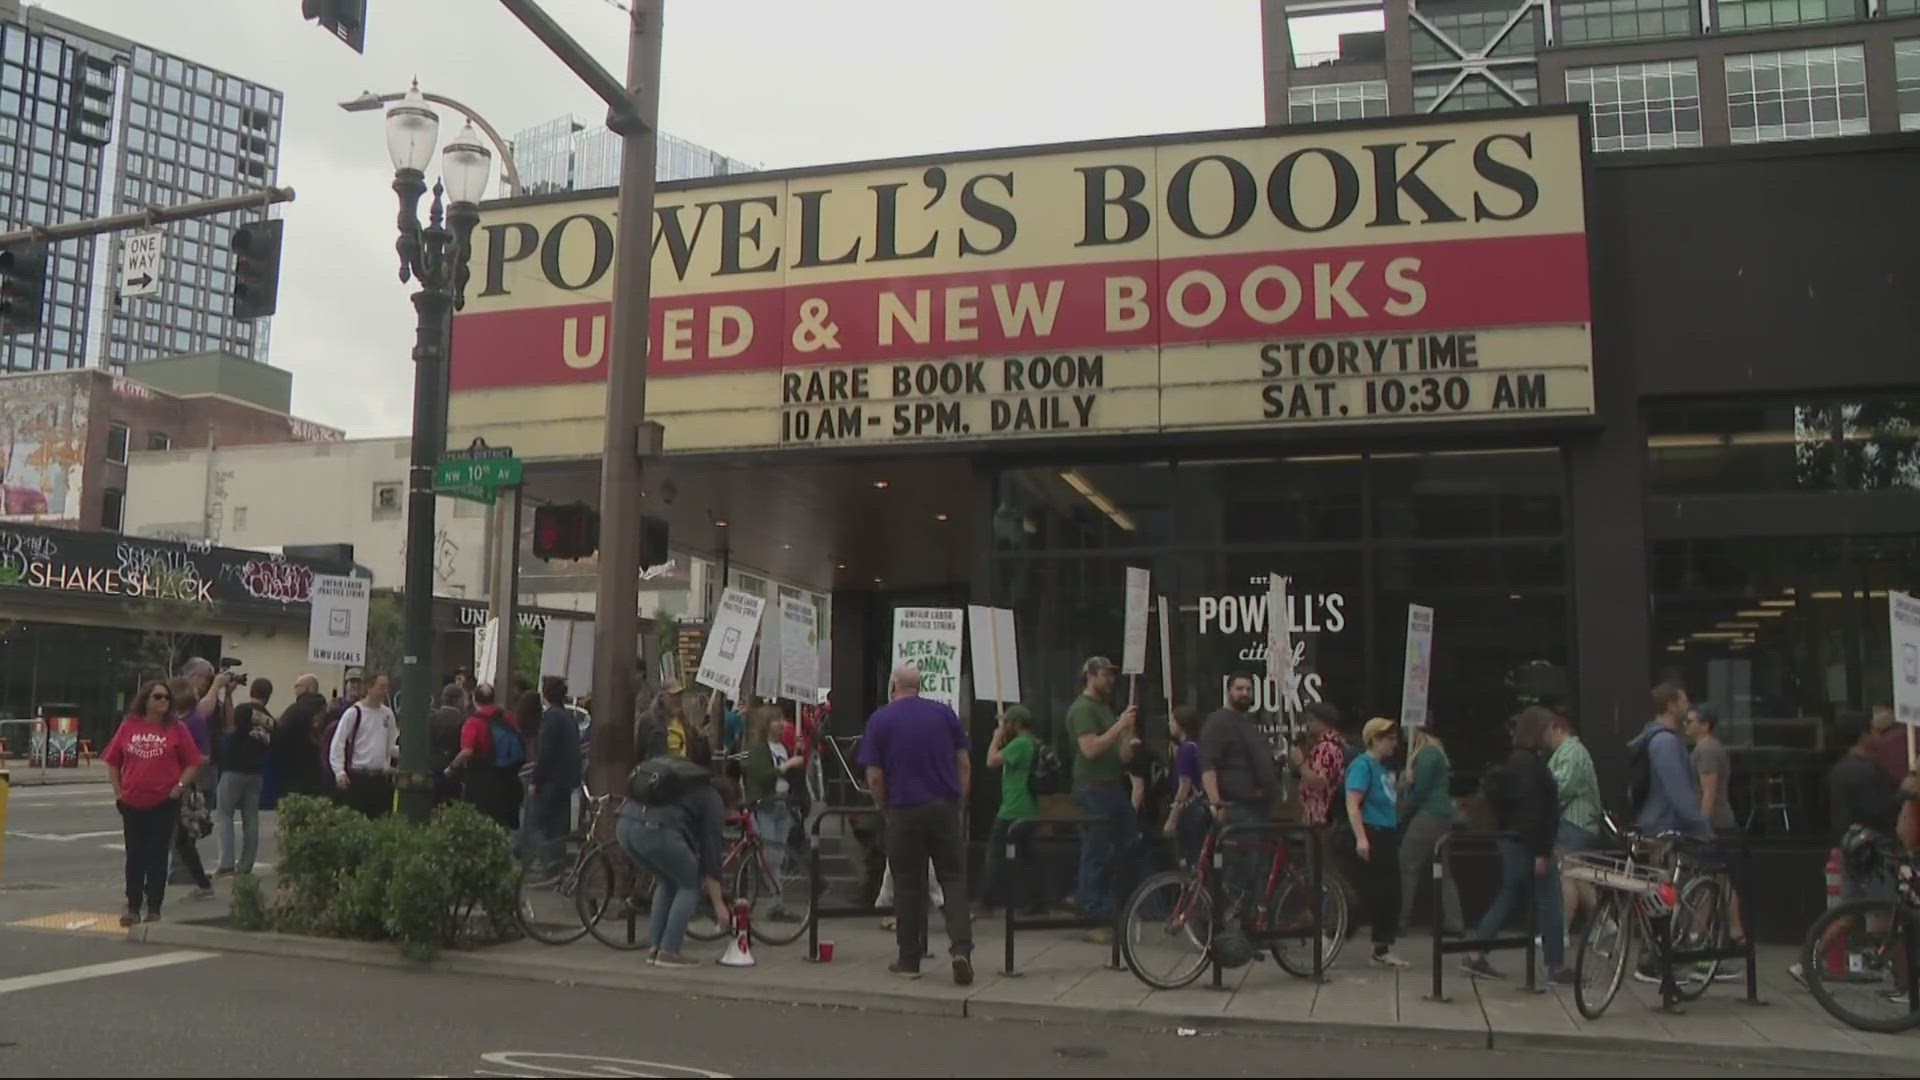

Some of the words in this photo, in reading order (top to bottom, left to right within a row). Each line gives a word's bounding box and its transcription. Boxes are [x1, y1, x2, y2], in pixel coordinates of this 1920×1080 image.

[477, 166, 1018, 299] POWELL'S
[1072, 131, 1540, 250] BOOKS
[131, 237, 156, 254] ONE
[129, 253, 156, 270] WAY
[562, 305, 754, 370] UED
[791, 297, 842, 351] &
[878, 280, 1065, 347] NEW
[1104, 256, 1428, 333] BOOKS
[1260, 334, 1479, 378] STORYTIME
[782, 367, 869, 403] RARE
[892, 361, 986, 398] BOOK
[1003, 355, 1104, 392] ROOM
[1365, 376, 1470, 415] 10:30
[1491, 373, 1547, 410] AM
[990, 394, 1096, 432] DAILY
[445, 471, 461, 482] NW
[498, 468, 511, 479] AV
[28, 562, 121, 595] SHAKE
[126, 571, 215, 608] SHACK
[318, 586, 344, 597] PRACTICE
[345, 589, 365, 599] STRIKE
[322, 579, 342, 589] UNFAIR
[344, 581, 363, 591] LABOR
[1199, 593, 1345, 635] POWLL'S
[333, 650, 354, 662] LOCAL
[935, 640, 957, 660] NOT
[1238, 641, 1268, 661] cit
[941, 676, 956, 693] IT
